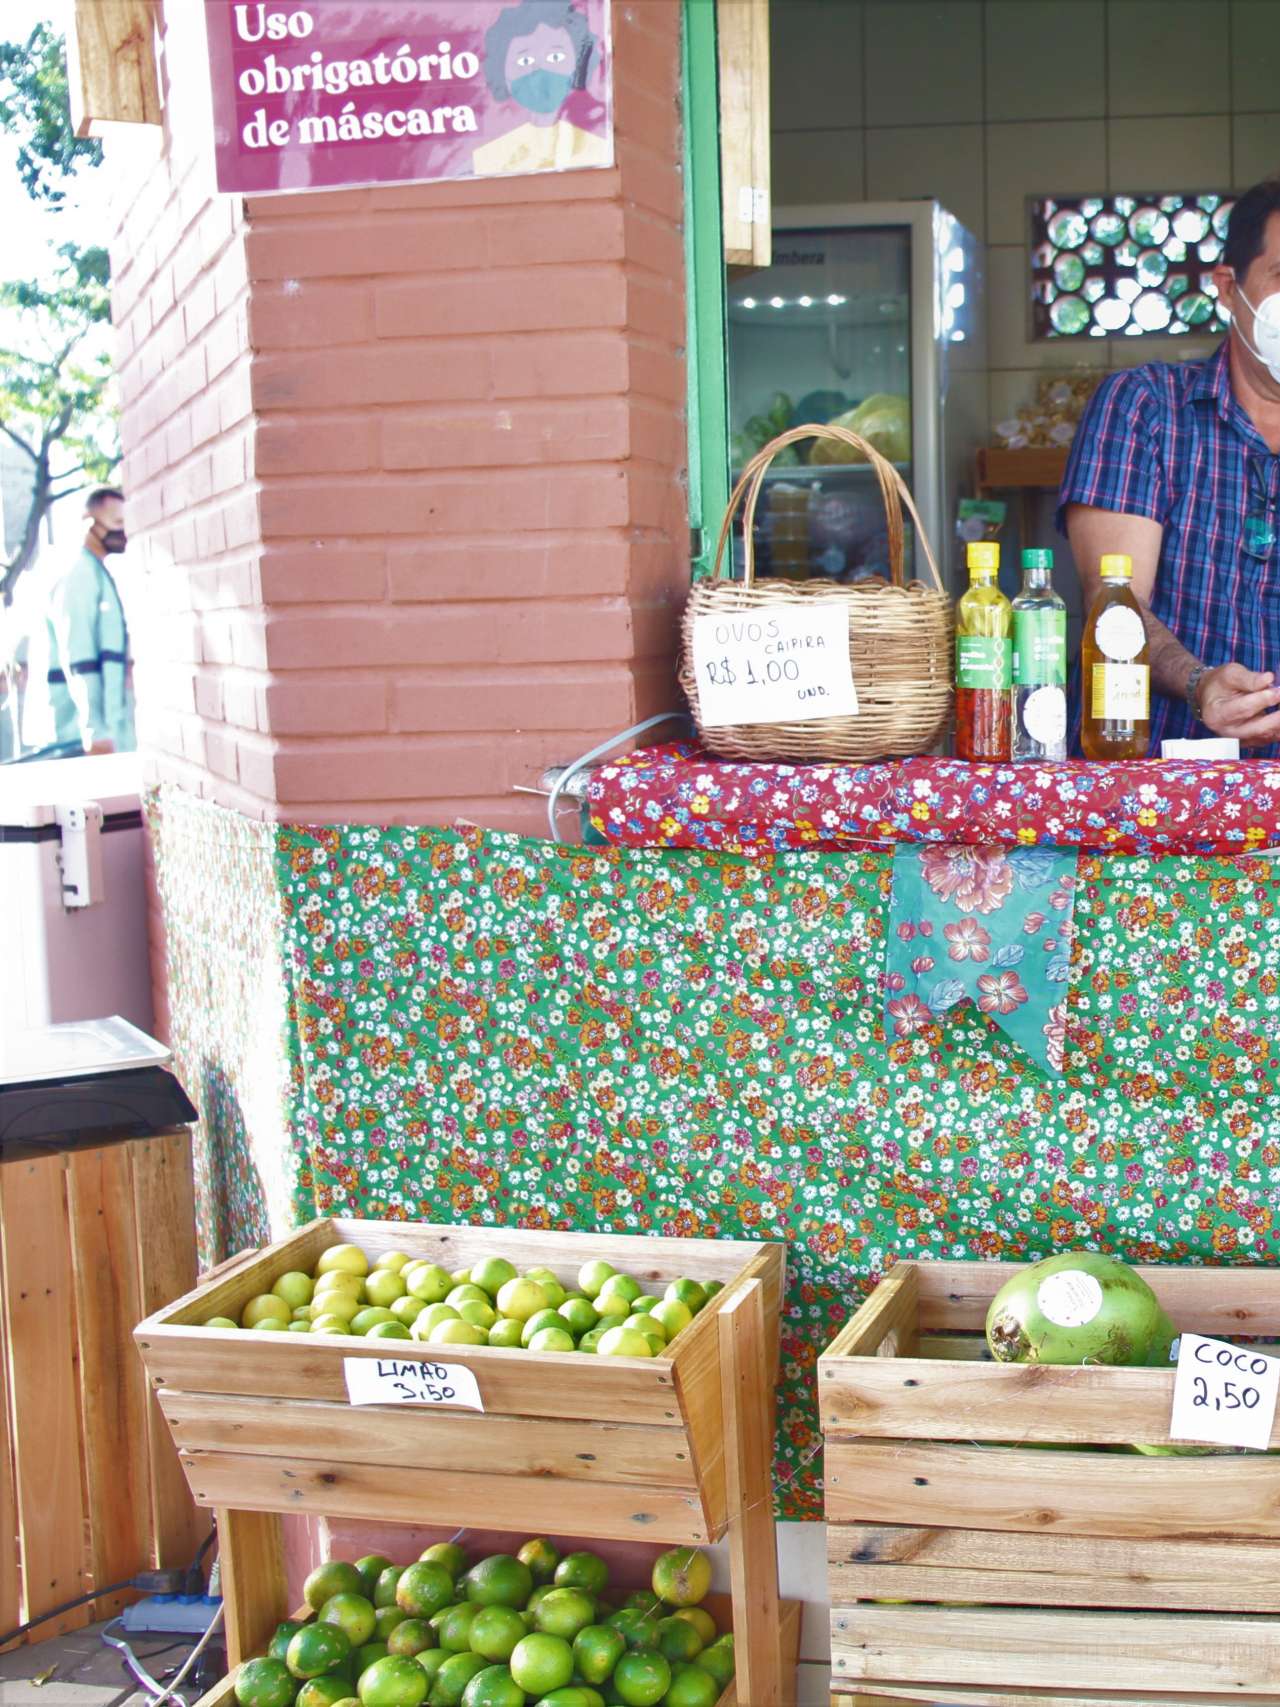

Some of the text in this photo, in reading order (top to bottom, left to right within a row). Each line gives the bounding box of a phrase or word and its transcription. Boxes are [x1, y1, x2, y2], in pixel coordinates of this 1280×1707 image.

[235, 5, 313, 42] Uso
[239, 41, 479, 95] obrigatório
[243, 101, 477, 148] de máscara
[715, 619, 780, 645] OVOS
[764, 635, 825, 655] CAIPIRA
[706, 656, 800, 687] R$ 1,00
[1195, 1343, 1268, 1376] COCO
[1192, 1376, 1260, 1411] 2,50
